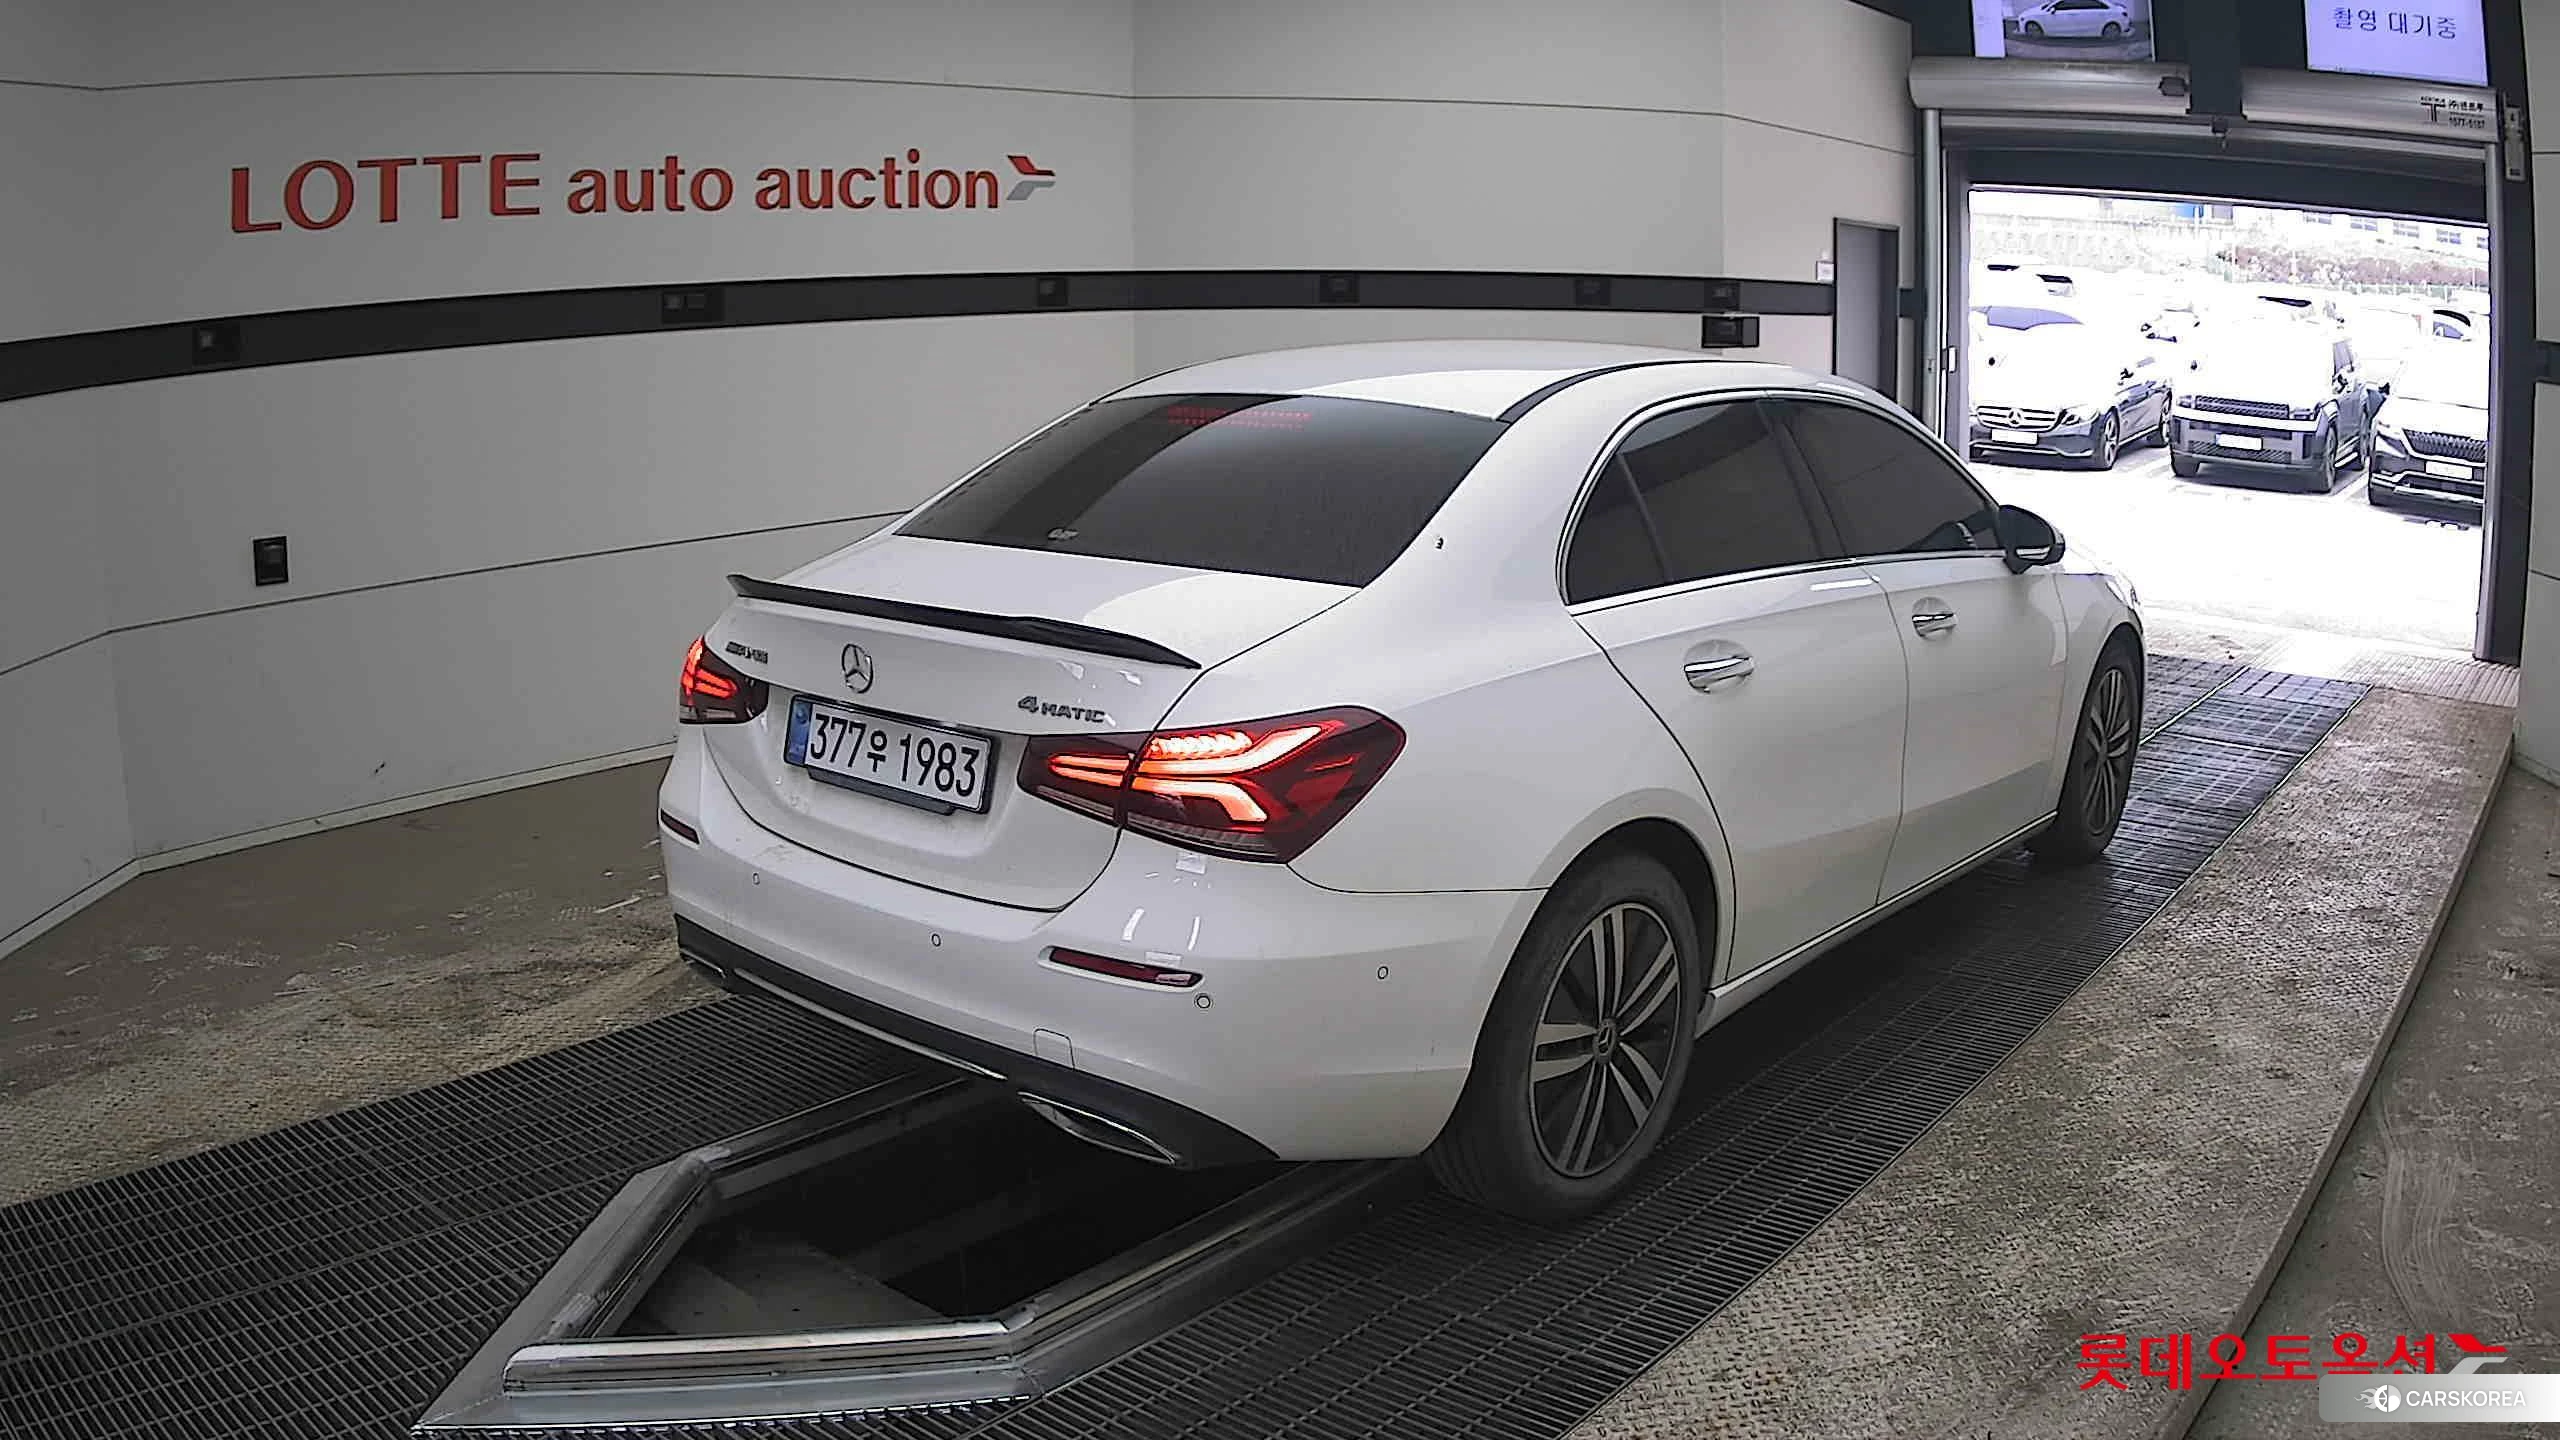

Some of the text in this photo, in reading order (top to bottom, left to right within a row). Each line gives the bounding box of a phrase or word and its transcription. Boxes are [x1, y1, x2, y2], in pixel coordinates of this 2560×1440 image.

[2333, 7, 2457, 40] 촬영 대기중
[230, 148, 1001, 234] LOTTE auto auction
[810, 712, 980, 798] 377우 1983
